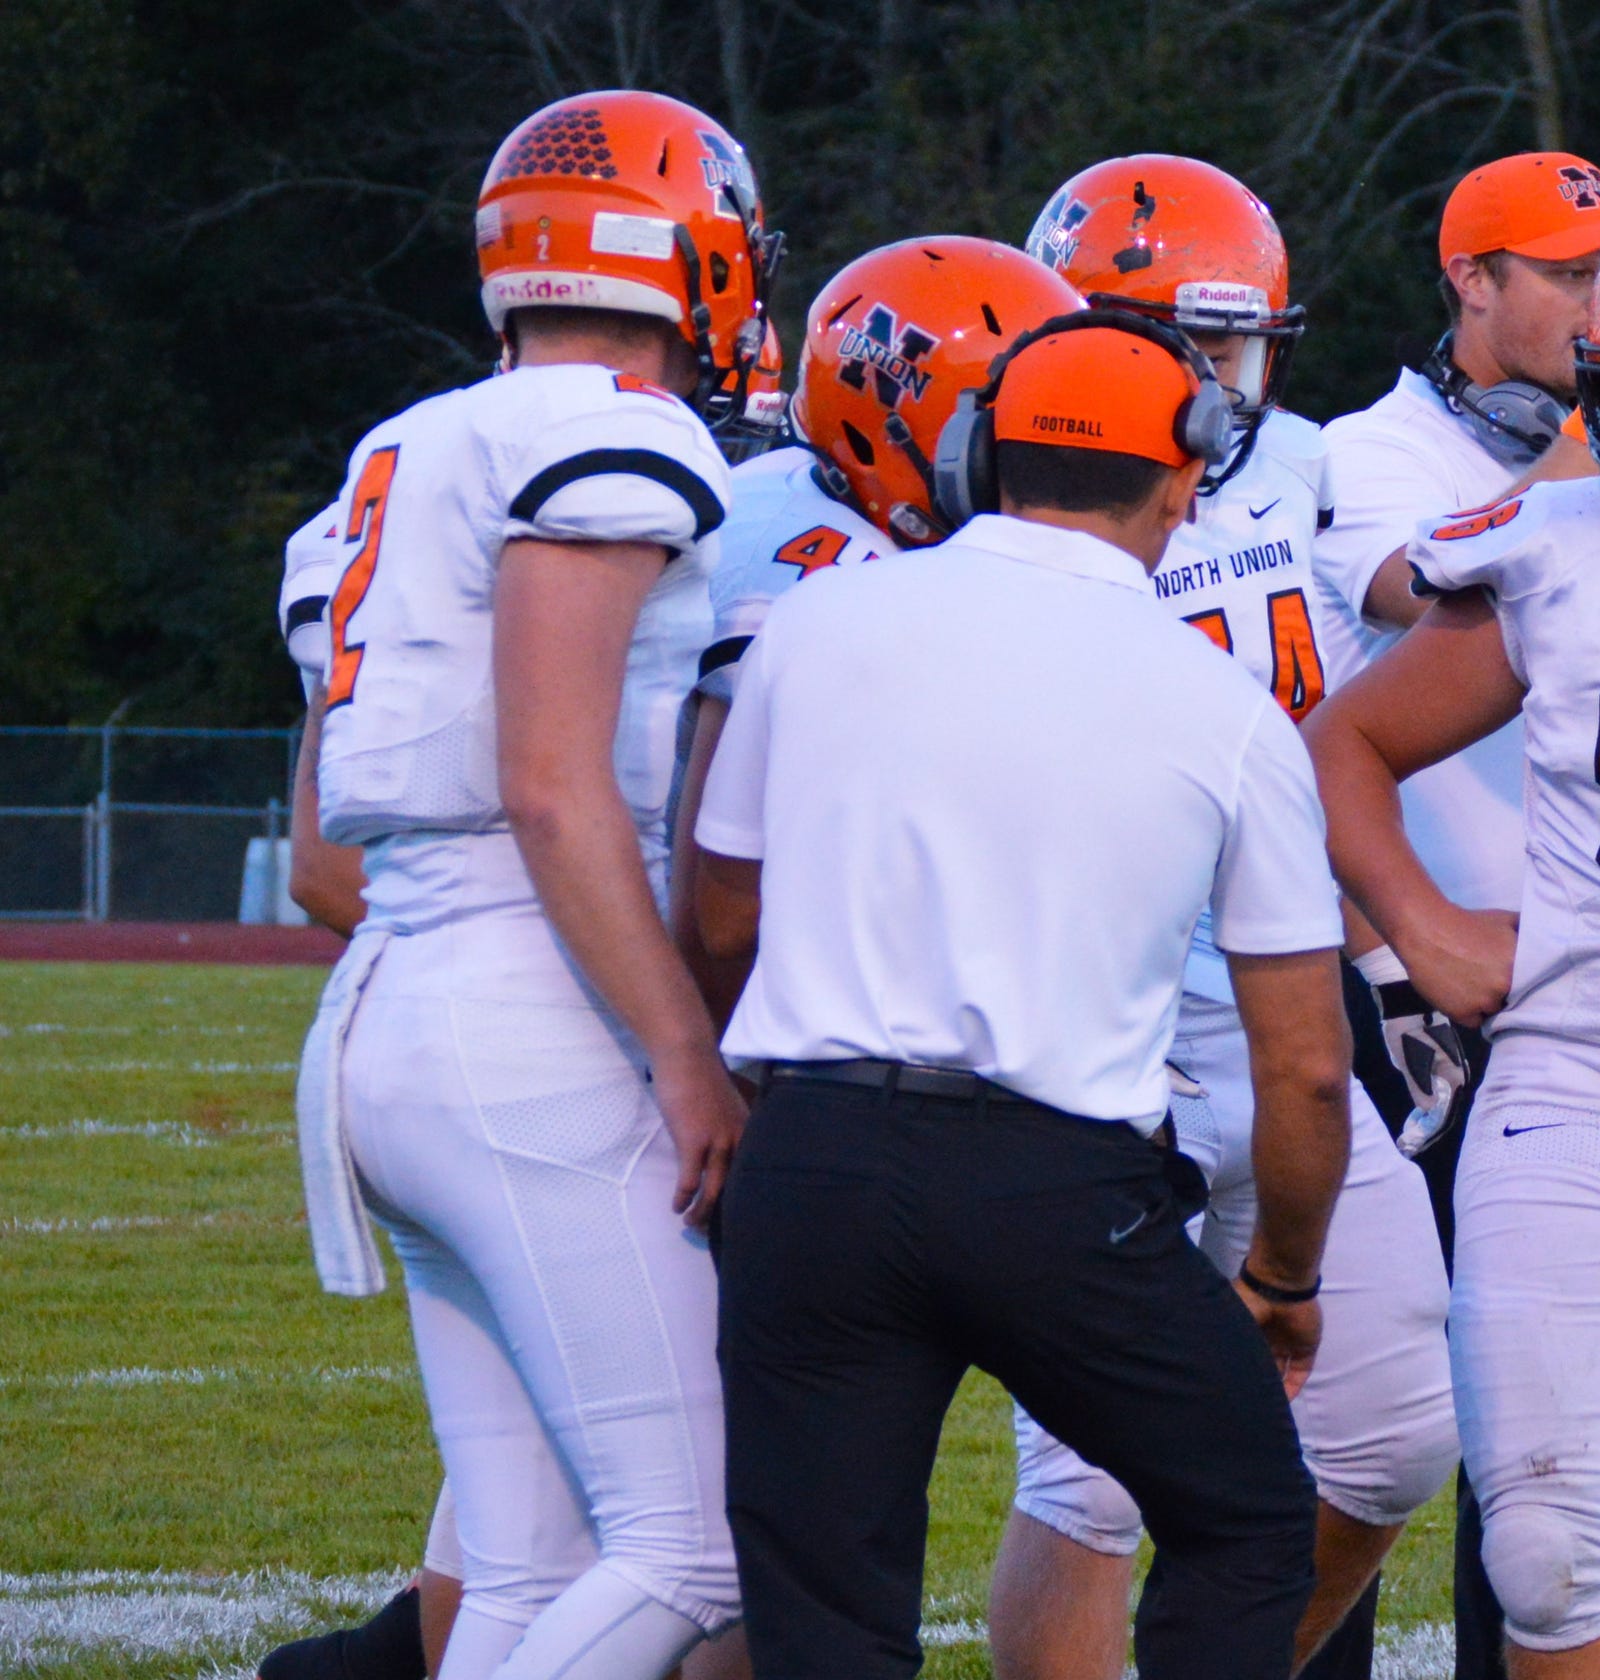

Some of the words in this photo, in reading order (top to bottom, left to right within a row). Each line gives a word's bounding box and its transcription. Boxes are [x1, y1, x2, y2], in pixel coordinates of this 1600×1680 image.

[537, 234, 549, 261] 2
[1198, 287, 1247, 302] Riddell
[838, 326, 933, 403] UNION
[1032, 414, 1104, 437] FOOTBALL
[1152, 558, 1223, 600] NORTH
[1229, 538, 1294, 579] UNION
